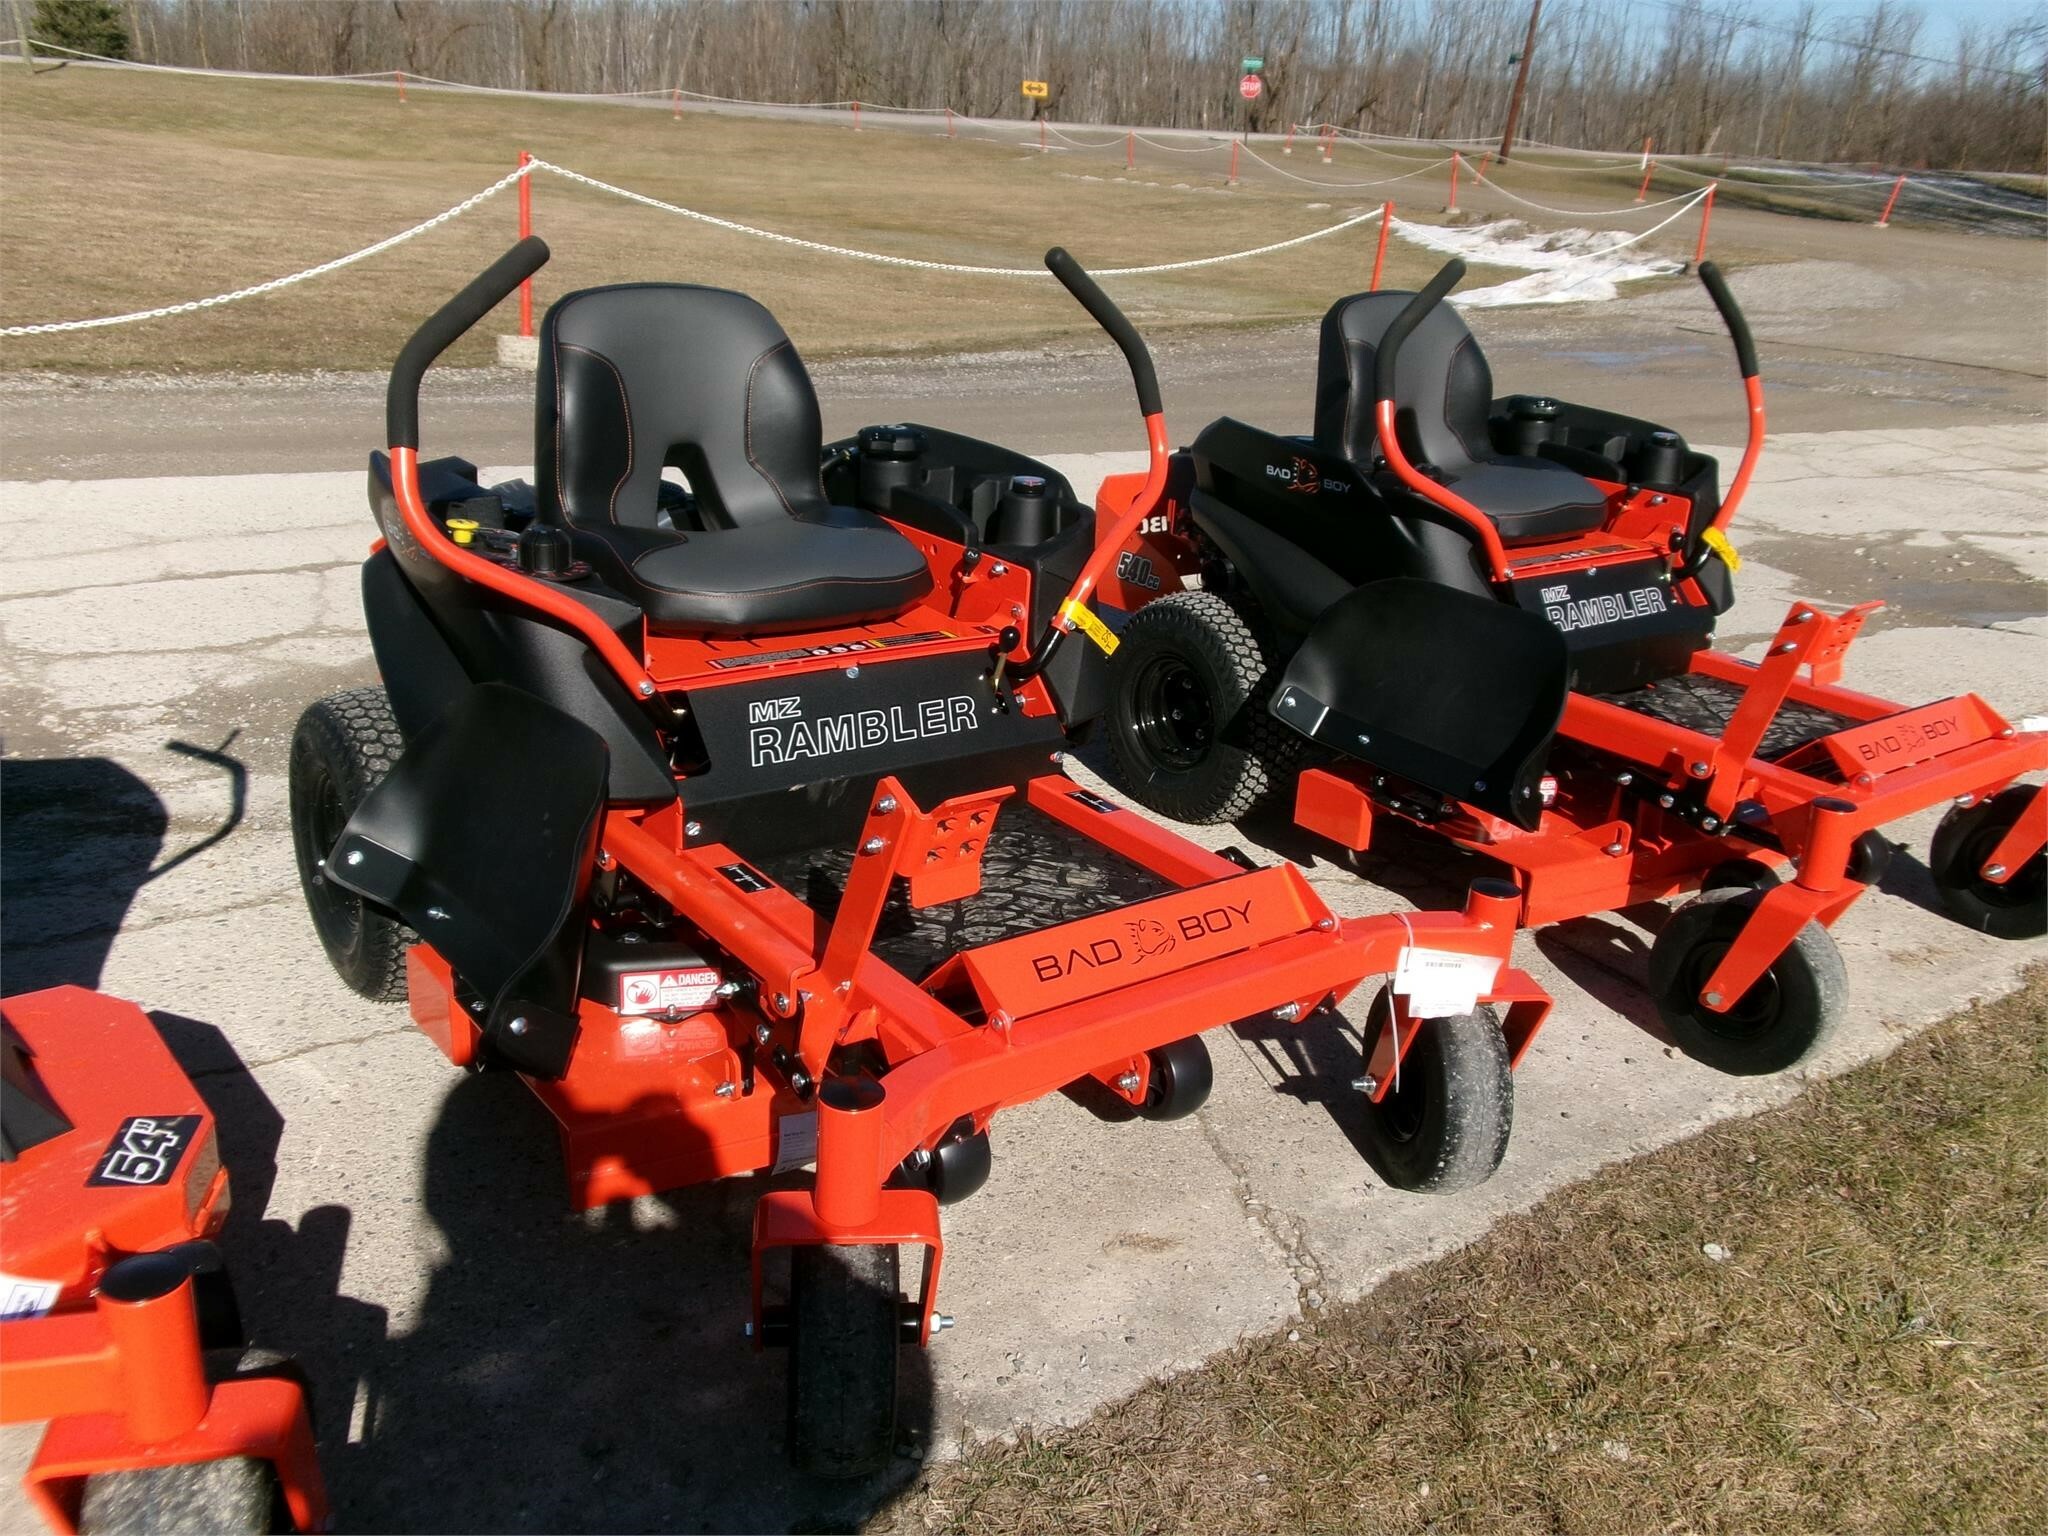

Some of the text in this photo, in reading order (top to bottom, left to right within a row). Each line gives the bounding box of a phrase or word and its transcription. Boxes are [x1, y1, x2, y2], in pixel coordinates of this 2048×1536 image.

[1241, 82, 1261, 91] STOP
[1266, 464, 1351, 493] BAD BOY
[1116, 551, 1160, 590] 540cc
[1541, 585, 1570, 604] MZ
[1546, 587, 1667, 632] RAMBLER
[749, 696, 801, 724] MZ
[750, 695, 978, 767] RAMBLER
[1858, 715, 1959, 761] BAD BOY
[1031, 900, 1252, 983] BAD BOY
[678, 972, 718, 986] DANGER
